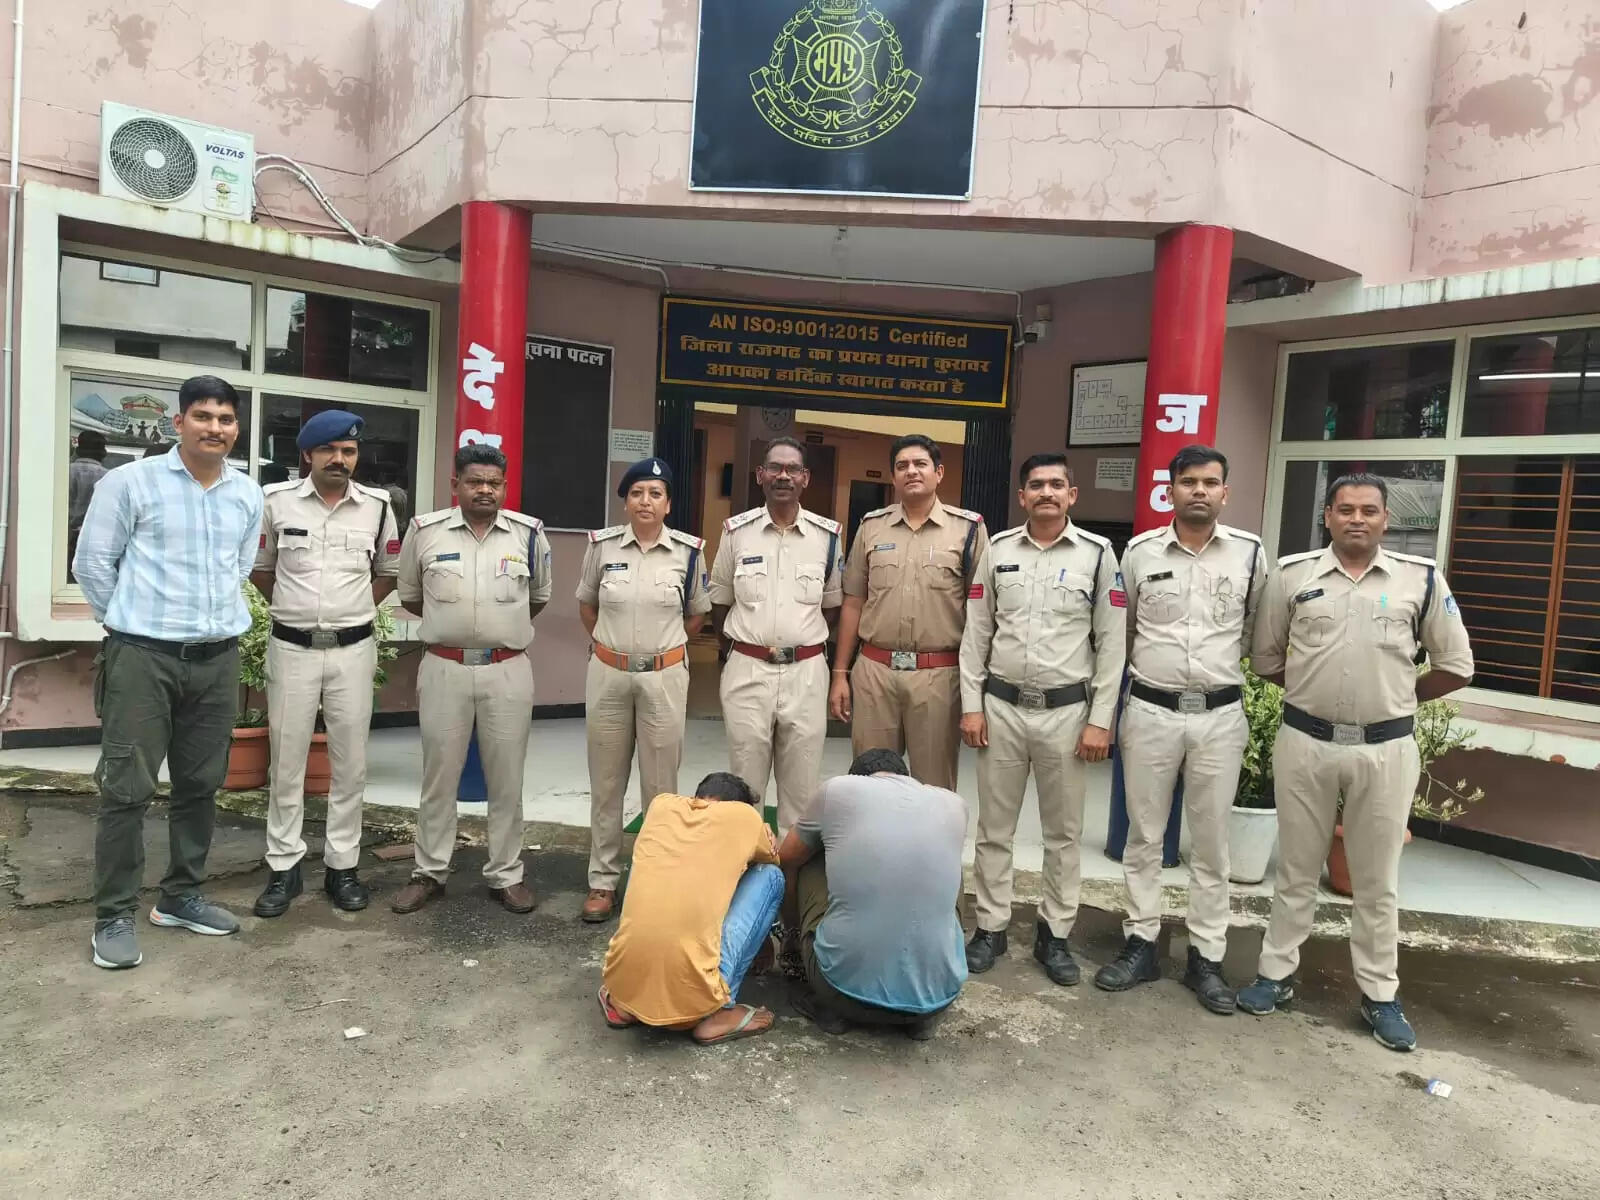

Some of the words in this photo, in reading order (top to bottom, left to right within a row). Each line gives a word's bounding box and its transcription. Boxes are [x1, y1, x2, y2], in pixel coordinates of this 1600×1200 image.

[767, 107, 787, 129] देश
[846, 131, 870, 143] जन
[876, 109, 903, 131] सेवा
[205, 144, 246, 159] VOLTAS
[709, 313, 737, 330] AN
[743, 315, 880, 342] ISO:9001:2015
[888, 329, 969, 349] Certified
[567, 347, 606, 366] पटल
[680, 335, 732, 353] जिला
[808, 347, 834, 361] का
[838, 349, 882, 366] प्रथम
[886, 353, 929, 369] थाना
[934, 357, 992, 374] कुरावर
[706, 363, 771, 380] आपका
[776, 367, 833, 385] हार्दिक
[837, 373, 896, 390] स्वागत
[900, 378, 948, 394] करता
[949, 376, 966, 394] है
